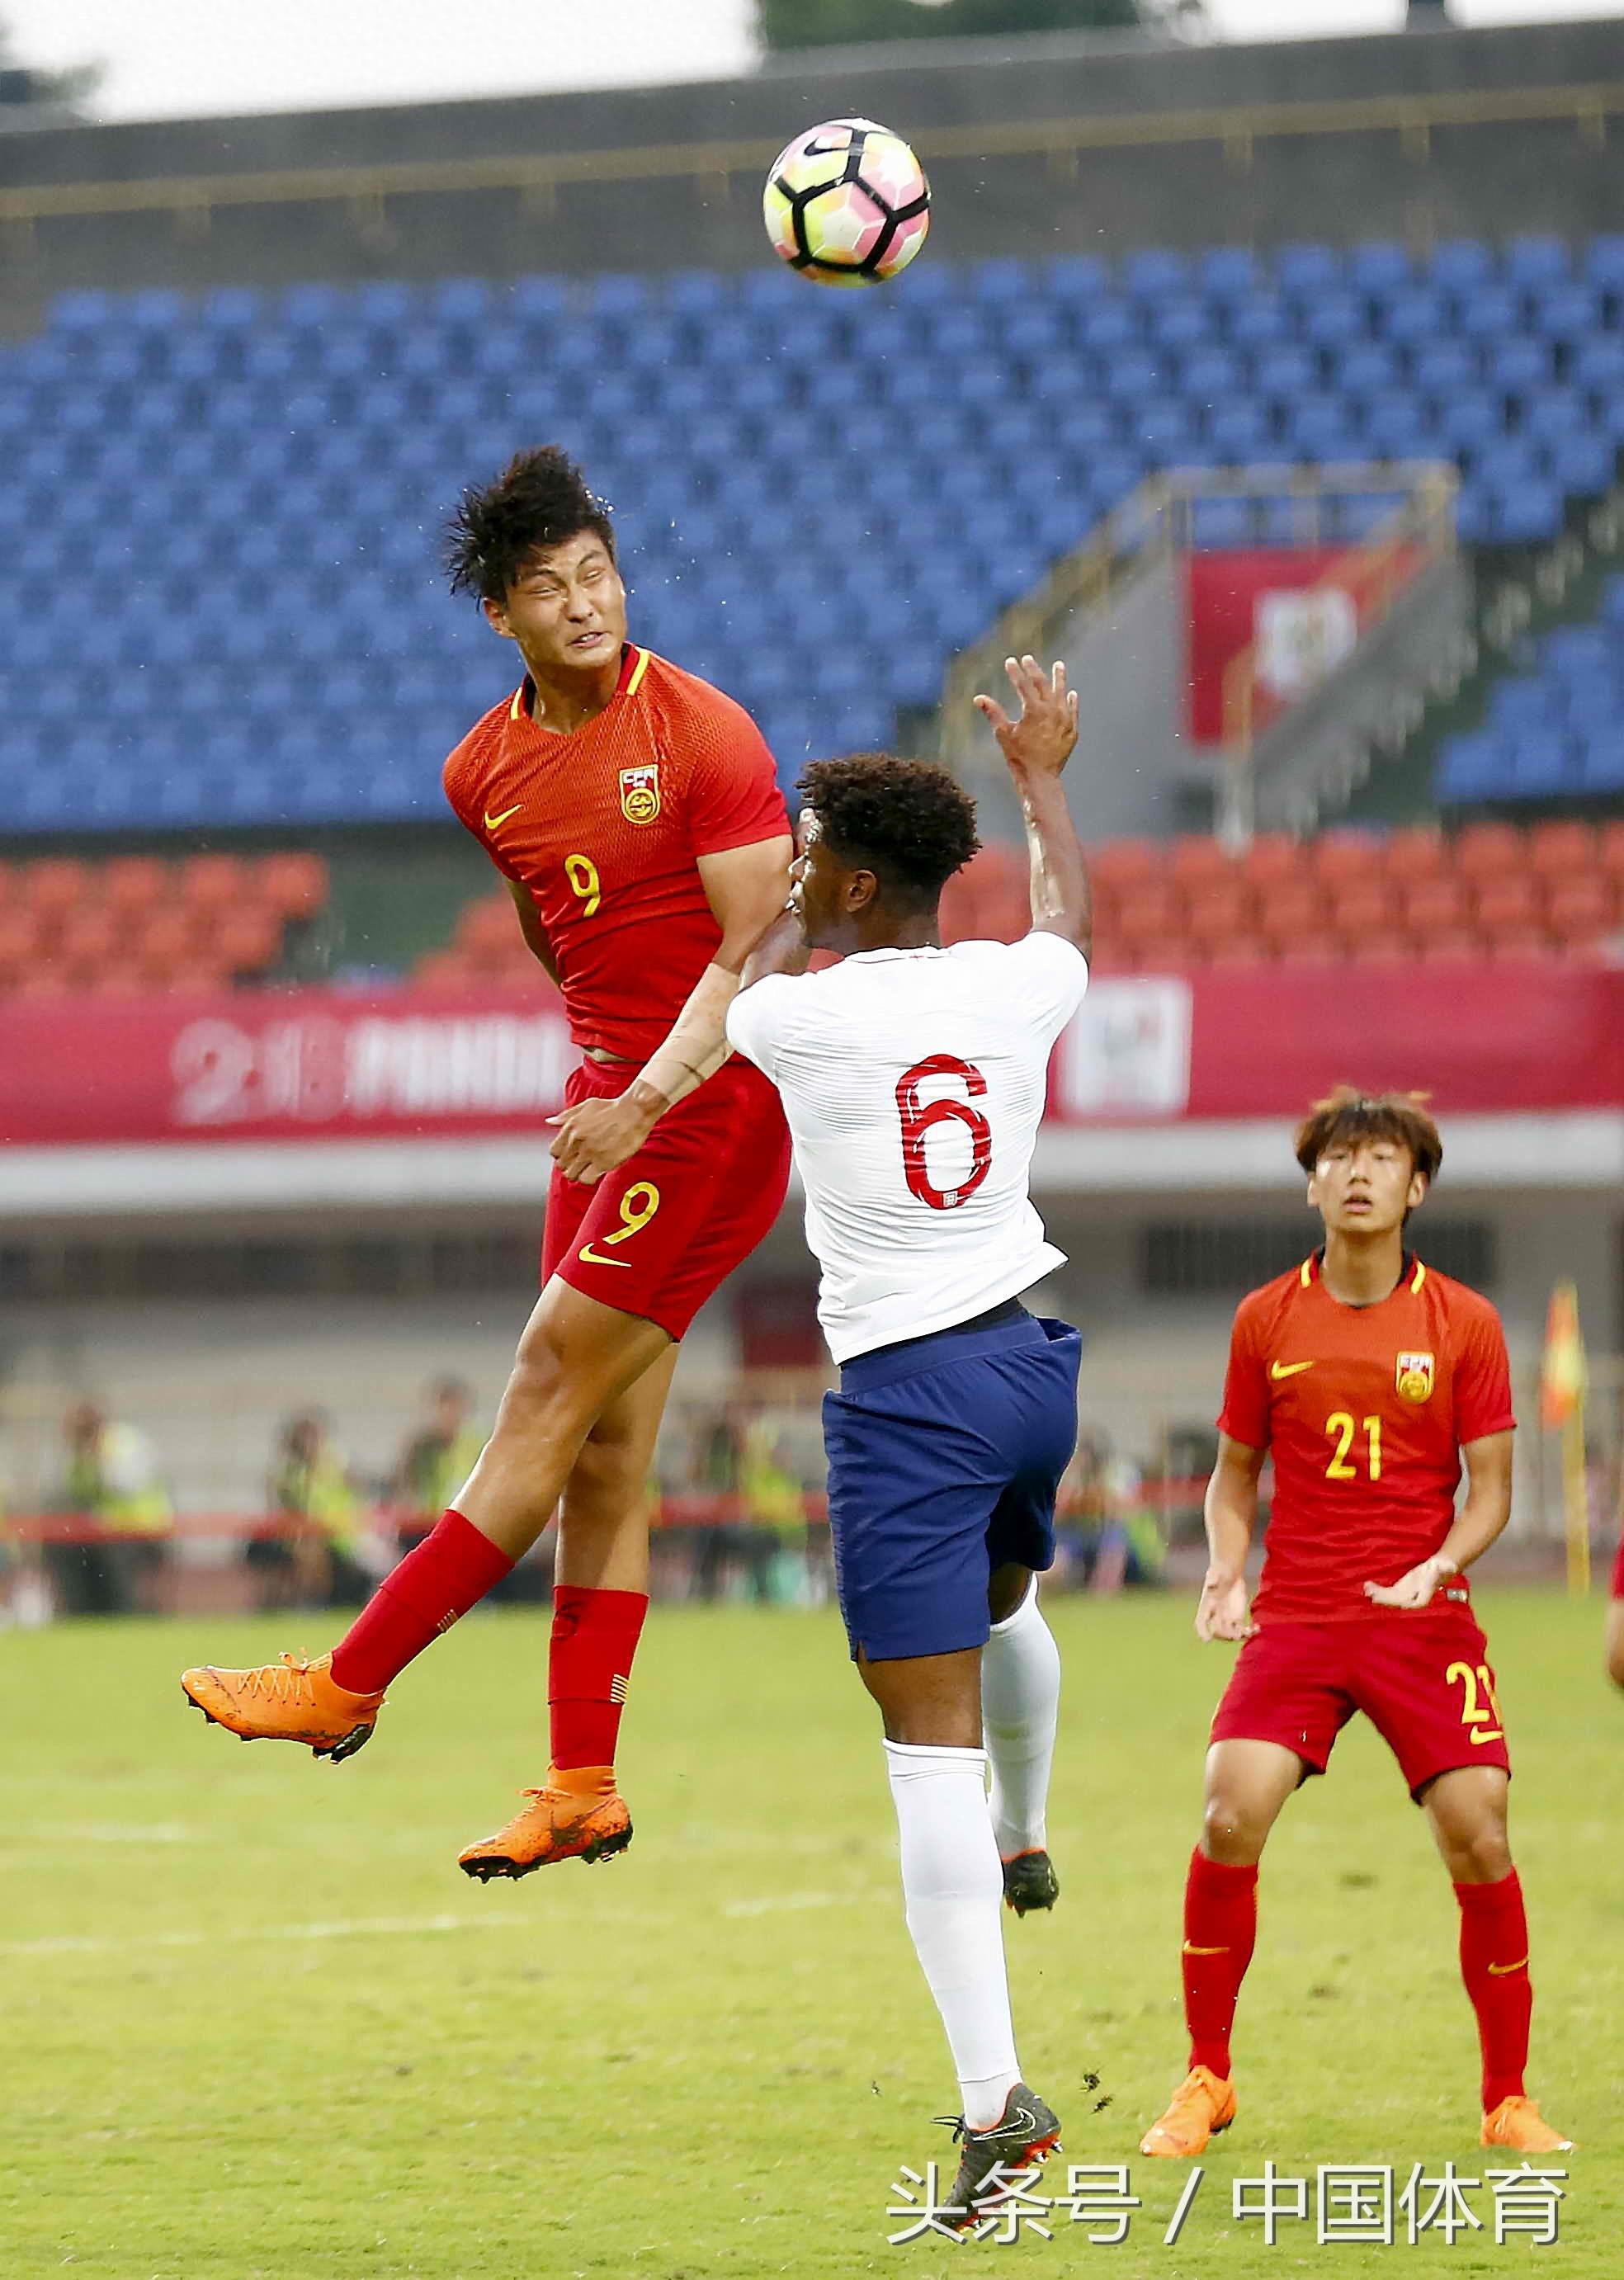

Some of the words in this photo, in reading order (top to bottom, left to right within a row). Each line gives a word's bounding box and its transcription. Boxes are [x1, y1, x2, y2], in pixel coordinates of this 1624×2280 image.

[564, 854, 601, 917] 9
[895, 1054, 992, 1210] 6
[602, 1181, 660, 1245] 9
[1325, 1411, 1381, 1481] 21
[1446, 1661, 1503, 1724] 21
